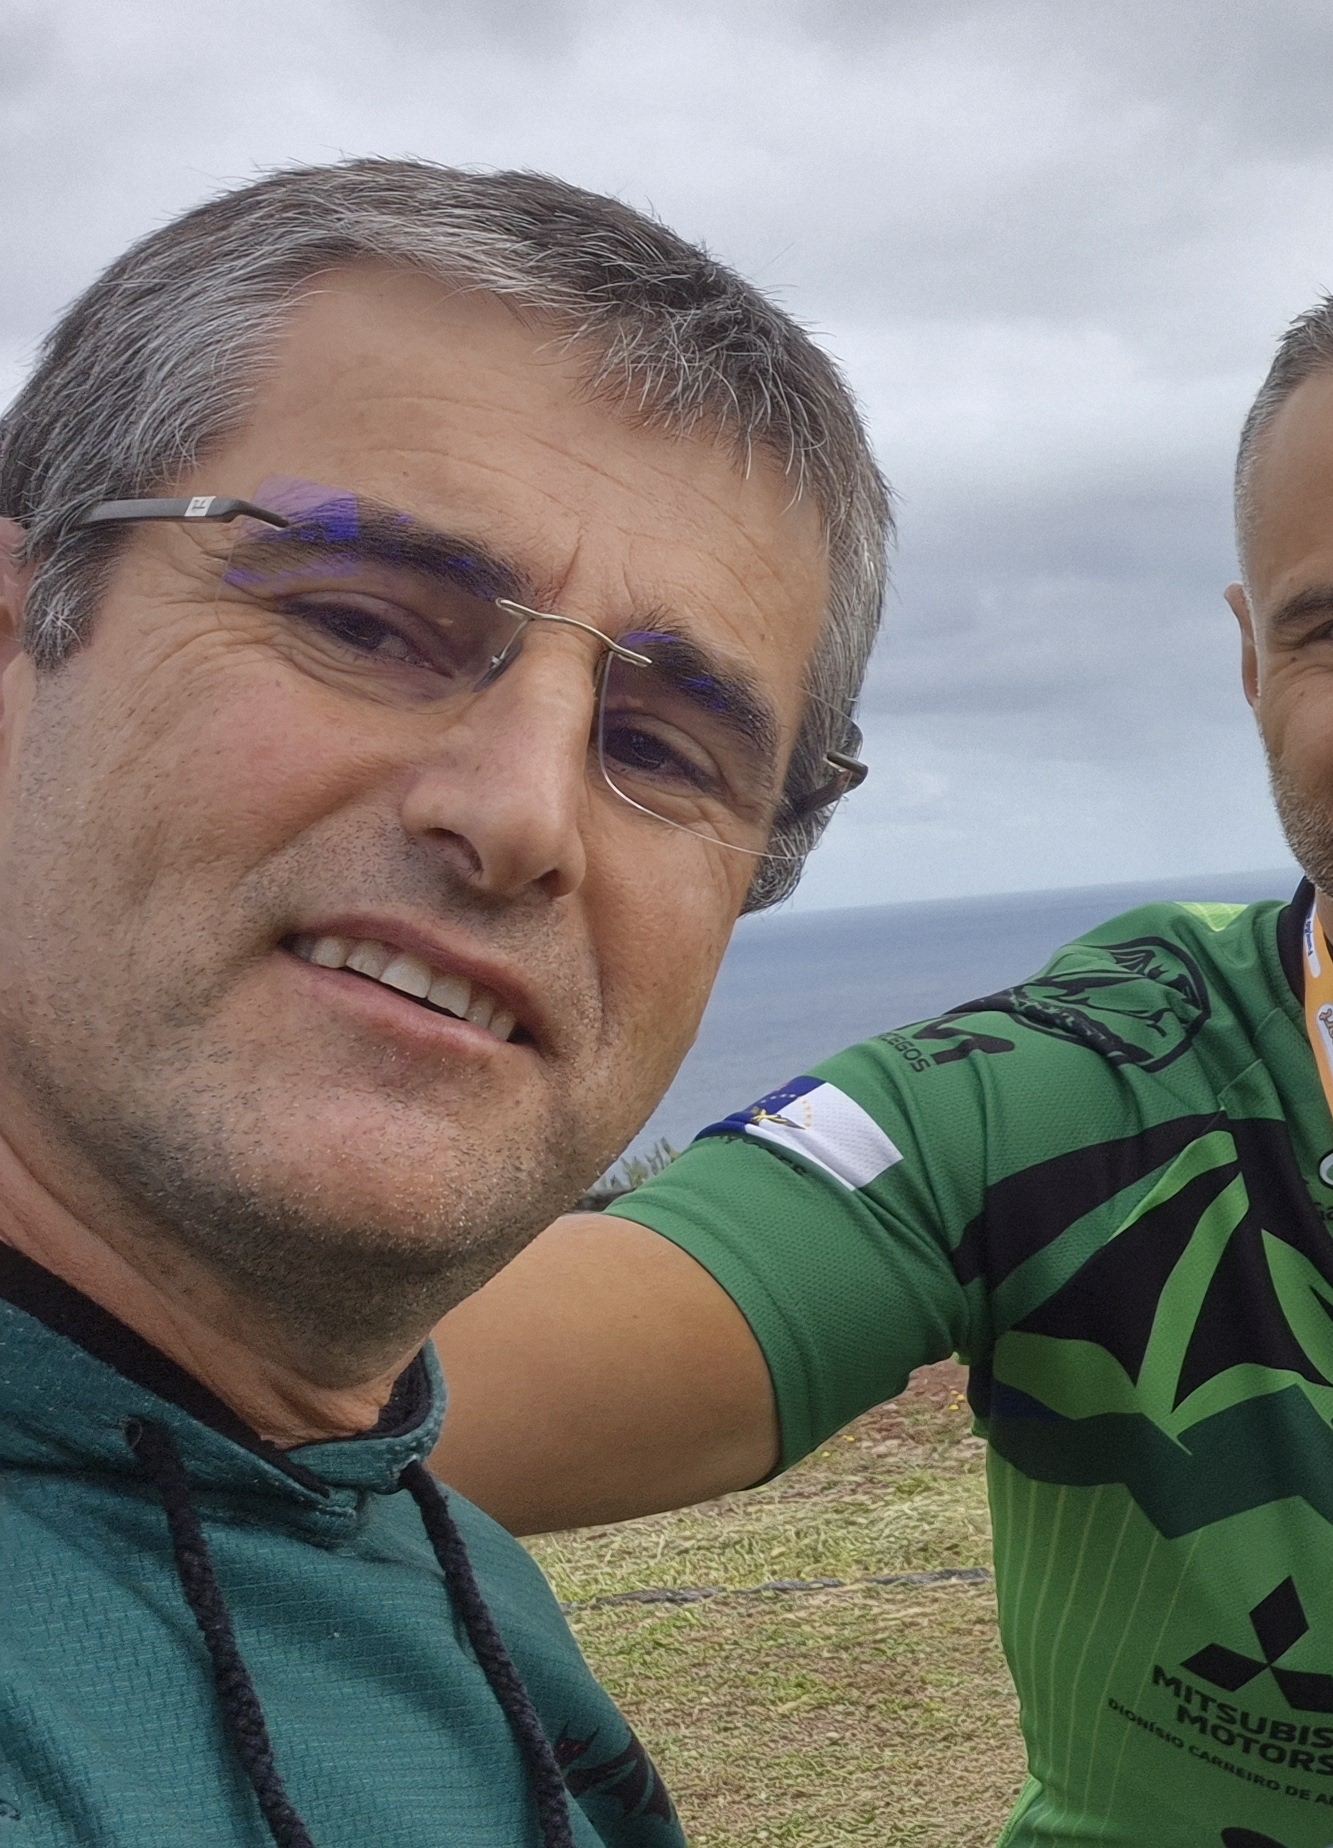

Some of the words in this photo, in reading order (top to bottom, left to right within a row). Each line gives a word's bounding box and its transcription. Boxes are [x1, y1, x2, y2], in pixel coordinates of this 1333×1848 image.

[878, 1032, 931, 1073] CEGOS
[1188, 1745, 1280, 1792] CARREIRO
[1284, 1784, 1312, 1801] DE
